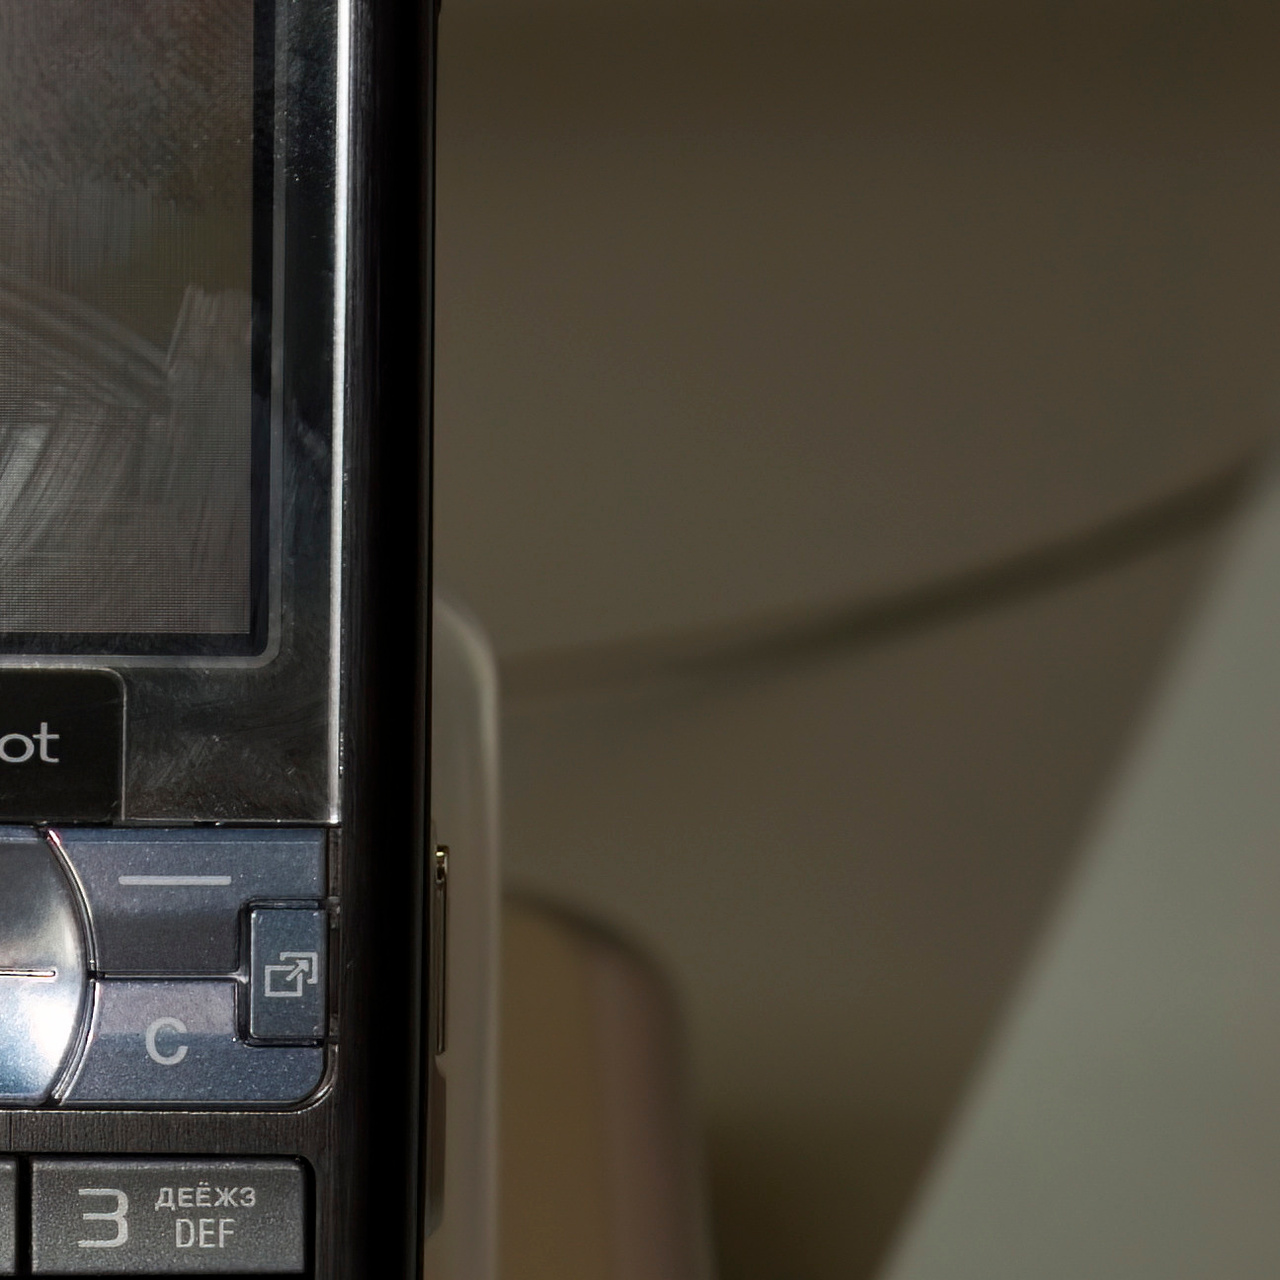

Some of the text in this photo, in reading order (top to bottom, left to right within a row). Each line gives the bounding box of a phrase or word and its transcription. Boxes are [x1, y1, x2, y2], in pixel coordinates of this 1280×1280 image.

[144, 1017, 189, 1067] C
[154, 1180, 257, 1212] ДЕЁЖЗ
[76, 1188, 128, 1248] 3
[175, 1217, 236, 1249] DEF
